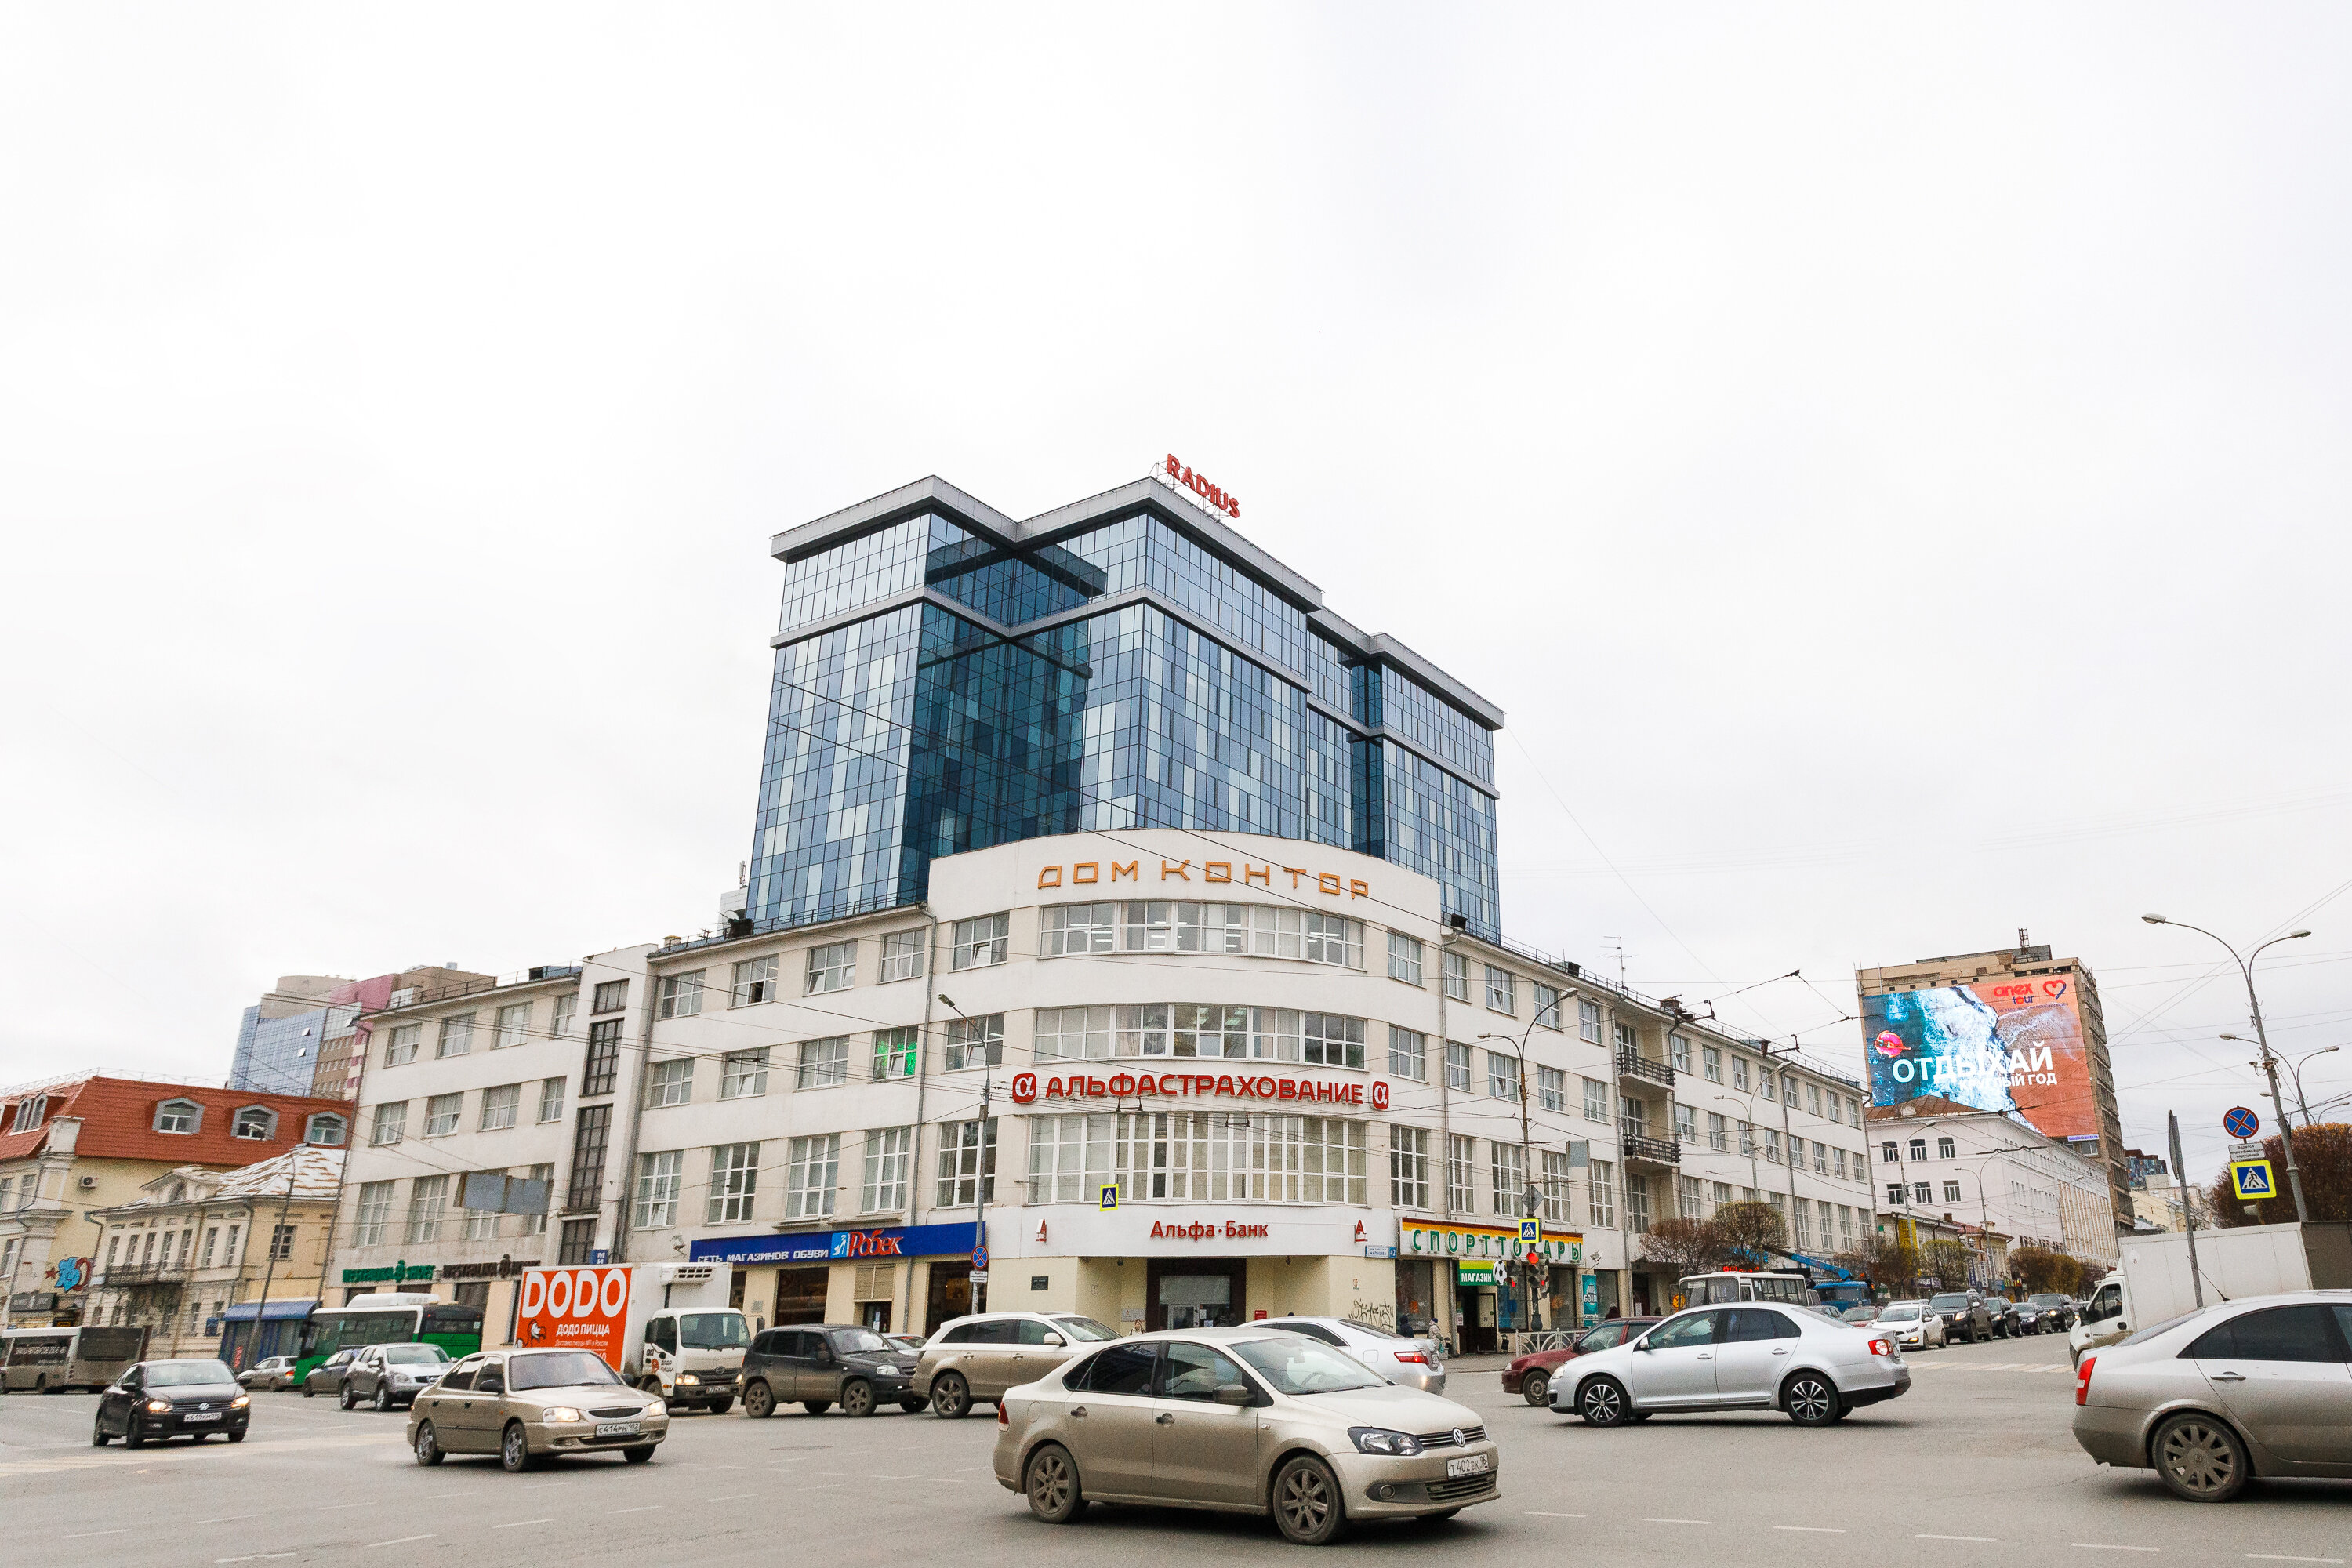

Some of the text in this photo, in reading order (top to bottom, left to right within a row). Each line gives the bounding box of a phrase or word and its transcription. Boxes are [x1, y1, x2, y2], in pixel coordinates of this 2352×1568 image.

[1167, 454, 1240, 518] RADIUS
[1037, 859, 1369, 899] ДОМ КОНТОР
[1993, 983, 2033, 997] anex
[2012, 995, 2034, 1004] tour
[1892, 1041, 2053, 1083] ОТДЫХАЙ
[1045, 1073, 1363, 1105] АЛЬФАСТРАХОВАНИЕ
[2027, 1073, 2057, 1086] ГОД
[727, 1251, 789, 1262] МАГАЗИНОВ
[793, 1249, 829, 1259] ОБУВИ
[848, 1229, 904, 1257] Робек
[1412, 1229, 1582, 1261] СПОРТТОАРЫ
[1461, 1272, 1492, 1283] МАГАЗИН
[522, 1269, 626, 1318] DODO
[555, 1323, 610, 1337] ДОДО ПИЦЦА
